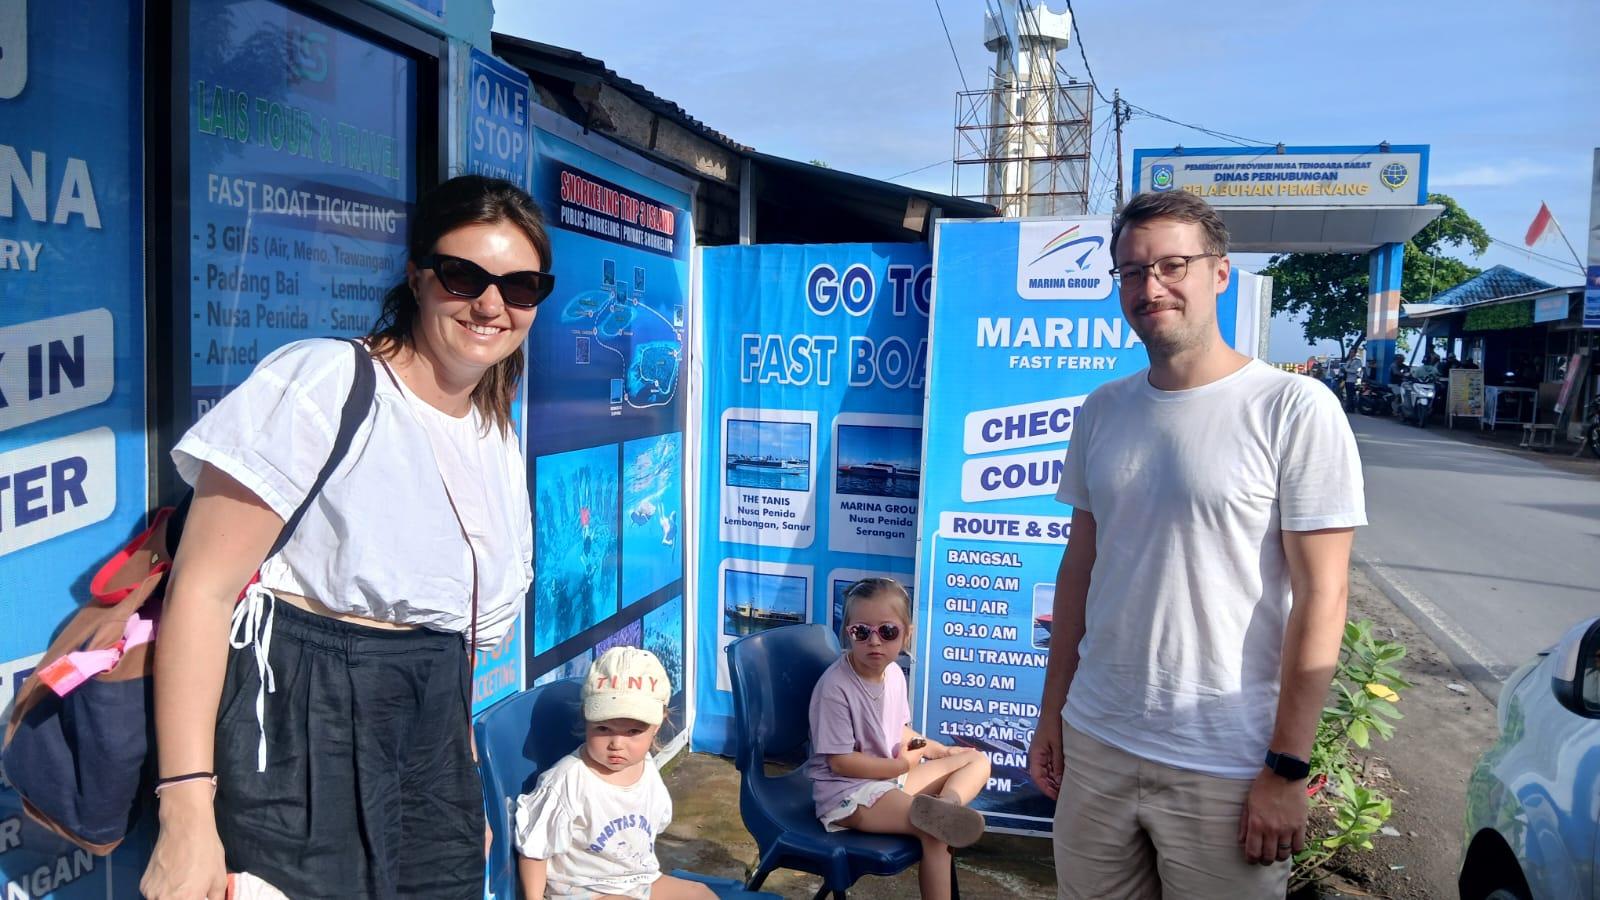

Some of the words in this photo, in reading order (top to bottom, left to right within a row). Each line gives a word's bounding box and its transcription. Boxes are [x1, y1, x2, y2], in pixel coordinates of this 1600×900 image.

[476, 74, 524, 125] ONE
[198, 80, 249, 143] LAIS
[255, 97, 313, 159] TOUR
[319, 117, 332, 163] &
[337, 121, 400, 180] TRAVEL
[474, 115, 523, 163] STOP
[1343, 161, 1372, 169] BARAT
[1214, 172, 1250, 182] DINAS
[1251, 172, 1338, 182] PERHUBUNGAN
[1277, 183, 1369, 196] PEMENANG
[208, 174, 256, 208] FAST
[262, 184, 311, 218] BOAT
[315, 194, 396, 234] TICKETING
[561, 170, 620, 218] SNORKELING
[620, 194, 640, 224] TRIP
[639, 201, 647, 227] 3
[646, 204, 675, 236] ISLAND
[561, 206, 585, 228] PUBLIC
[585, 213, 620, 238] SNORKELING
[206, 223, 217, 250] 3
[207, 264, 270, 299] Padang
[276, 271, 299, 296] Bai
[331, 276, 391, 302] Lembon
[805, 263, 876, 316] GO
[1028, 278, 1066, 288] MARINA
[1067, 278, 1101, 288] GROUP
[207, 302, 250, 328] Nusa
[256, 304, 308, 329] Penida
[331, 307, 369, 332] Sanur
[206, 338, 258, 366] Amed
[740, 333, 837, 386] FAST
[28, 335, 85, 401] IN
[1009, 355, 1053, 369] FAST
[1057, 356, 1117, 370] FERRY
[742, 494, 759, 504] THE
[761, 496, 790, 506] TANIS
[840, 501, 881, 512] MARINA
[737, 505, 760, 516] Nusa
[762, 508, 796, 518] Penida
[849, 514, 876, 525] Nusa
[878, 516, 913, 527] Penida
[724, 516, 779, 531] Lembongan,
[782, 521, 811, 531] Sanur
[856, 526, 905, 539] Serangan
[953, 517, 1020, 536] ROUTE
[1025, 521, 1042, 538] &
[948, 550, 1022, 567] BANGSAL
[946, 574, 990, 590] 09.00
[993, 577, 1019, 591] AM
[945, 598, 976, 613] GILI
[980, 600, 1008, 615] AIR
[944, 622, 988, 638] 09.10
[991, 626, 1017, 640] AM
[943, 647, 974, 662] GILI
[978, 649, 1049, 668] TRAWAN
[597, 676, 659, 692] TINY
[942, 671, 986, 688] 09.30
[989, 675, 1015, 690] AM
[941, 696, 984, 713] NUSA
[988, 700, 1041, 718] PENID
[988, 726, 1014, 741] AM
